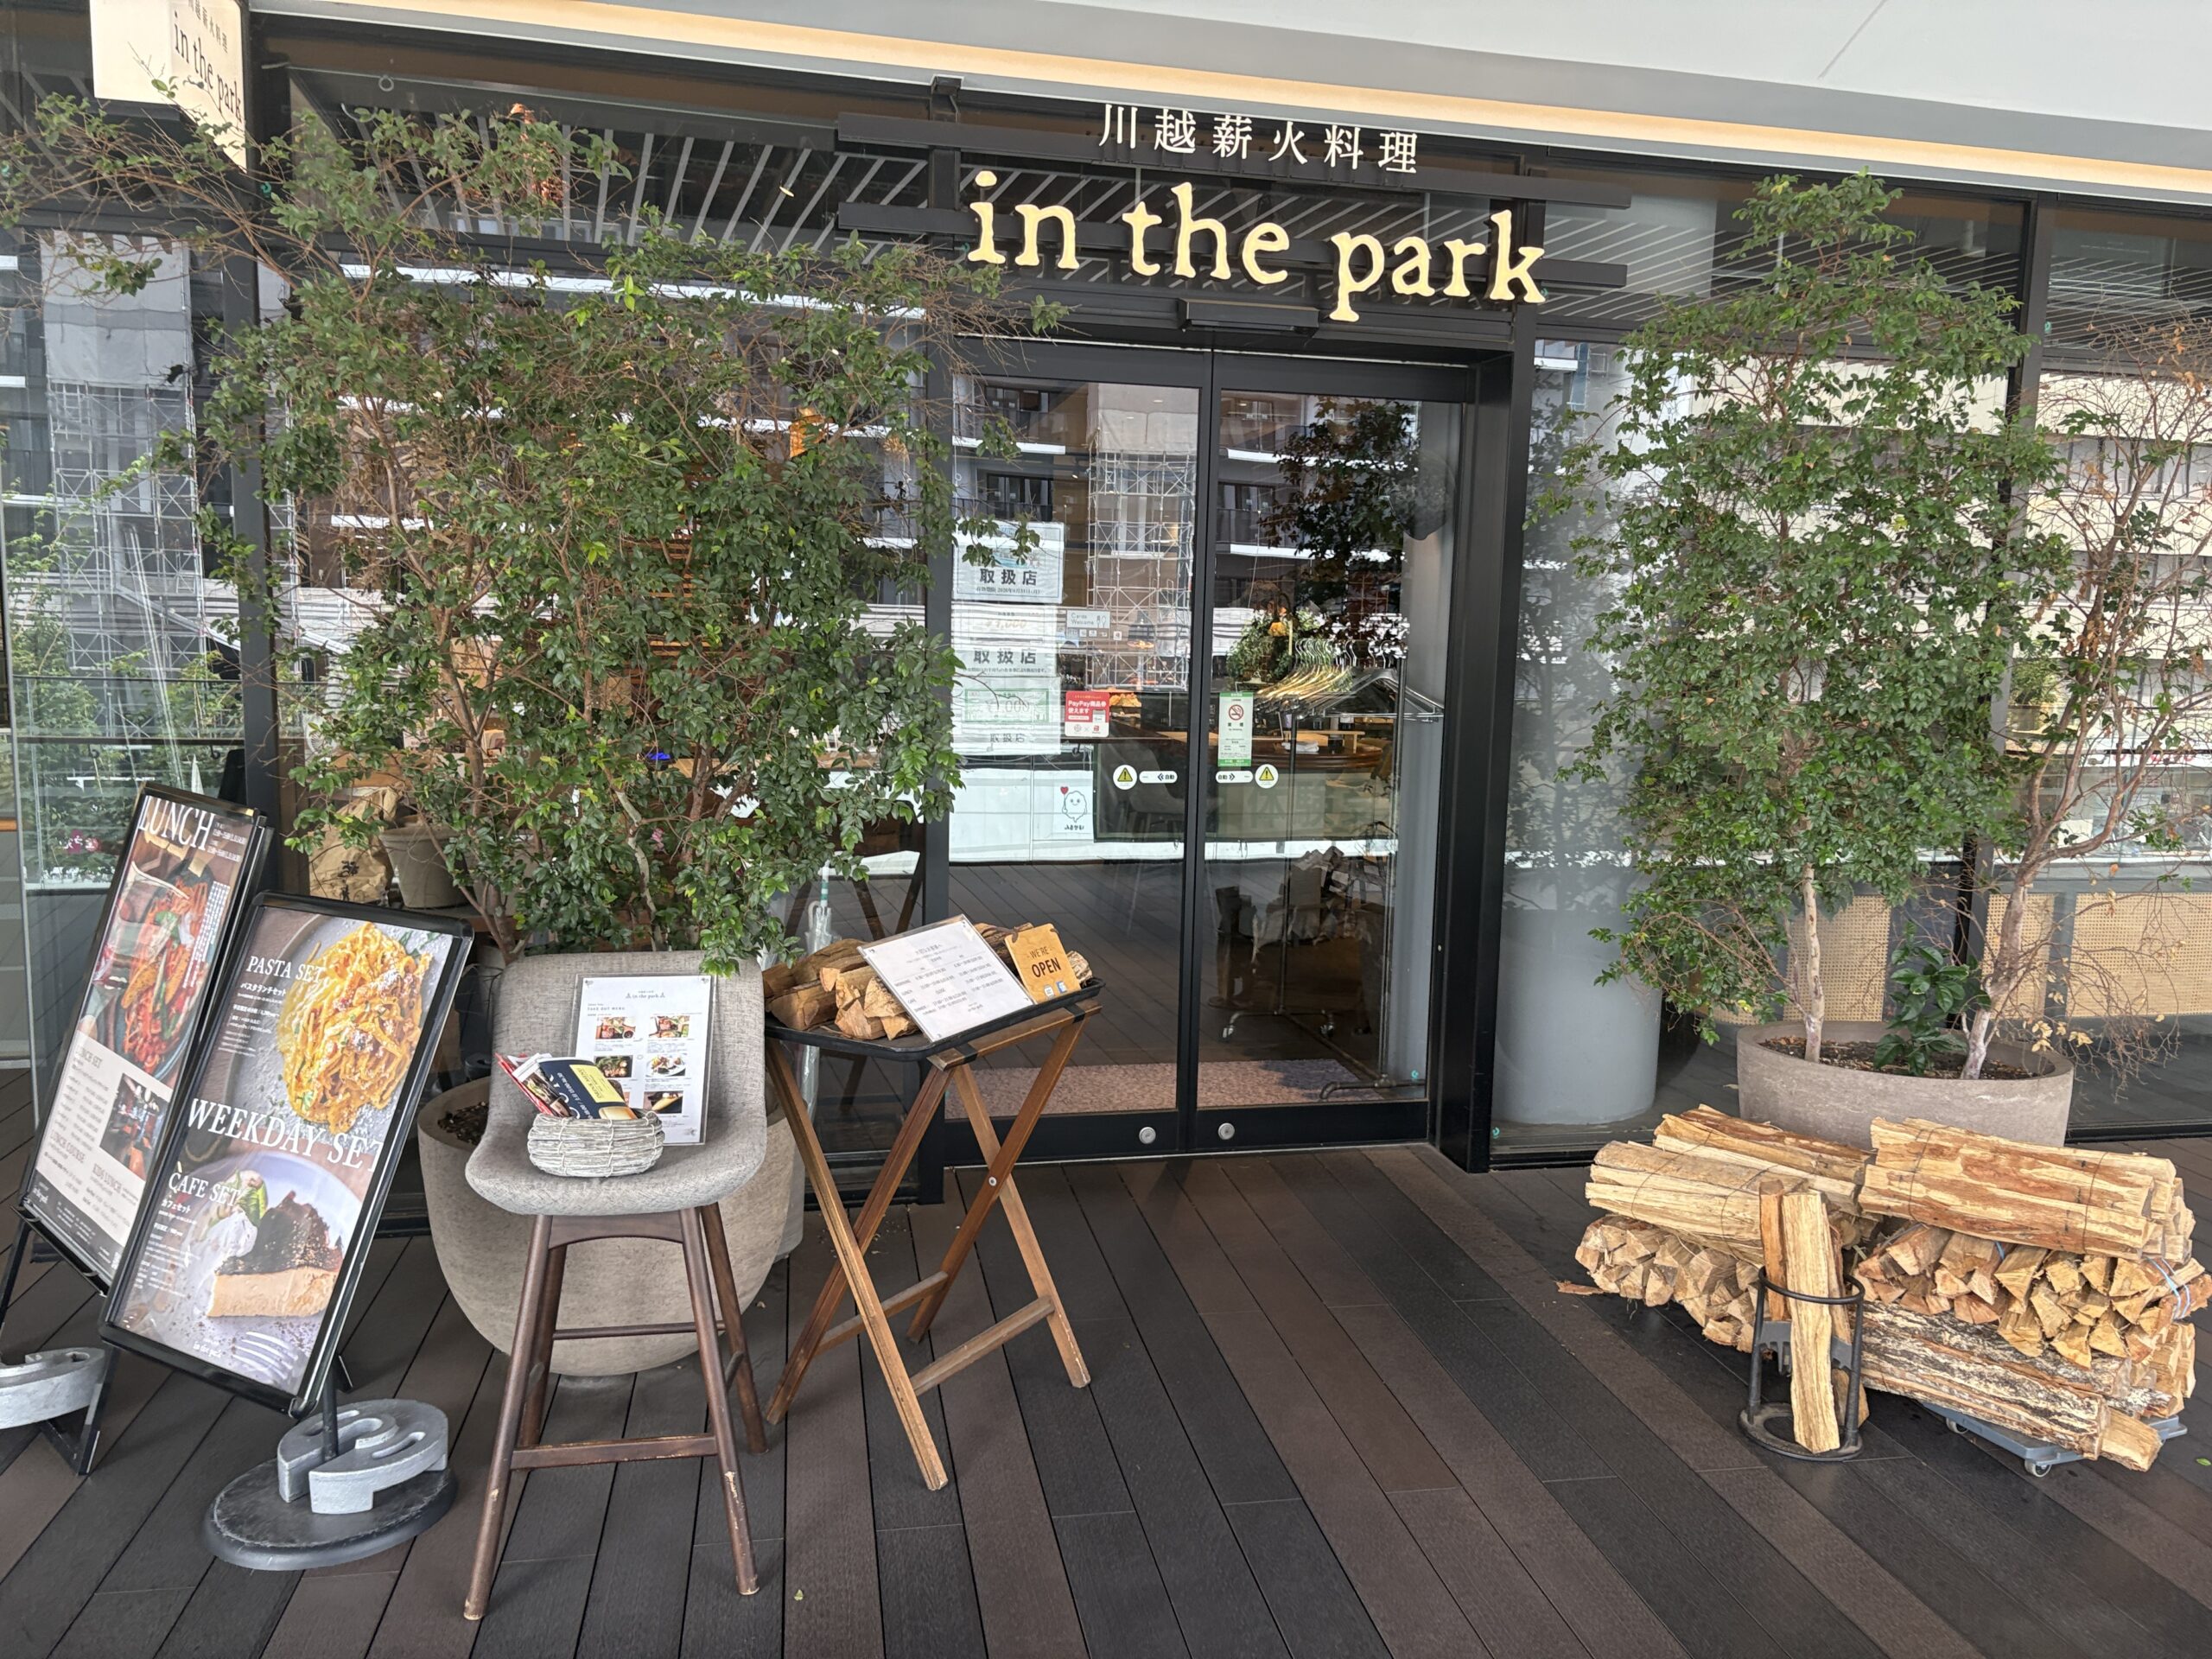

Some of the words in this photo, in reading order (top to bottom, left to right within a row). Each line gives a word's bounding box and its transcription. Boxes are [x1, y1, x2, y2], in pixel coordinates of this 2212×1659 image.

[175, 10, 188, 63] in
[194, 36, 213, 89] the
[217, 73, 242, 123] park
[1099, 105, 1418, 174] 川越薪火料理
[968, 170, 1079, 270] in
[1122, 181, 1290, 285] the
[1329, 210, 1546, 321] park
[980, 568, 1038, 586] 取扱店
[974, 649, 1037, 664] 取扱店
[138, 795, 216, 851] LUNCH
[1029, 945, 1050, 959] WE'RE
[1031, 957, 1062, 978] OPEN
[246, 956, 292, 979] PASTA
[296, 963, 326, 982] SET
[188, 1098, 327, 1156] WEEKDAY
[327, 1132, 384, 1173] SET
[168, 1173, 209, 1198] CAFE
[209, 1183, 241, 1206] SET
